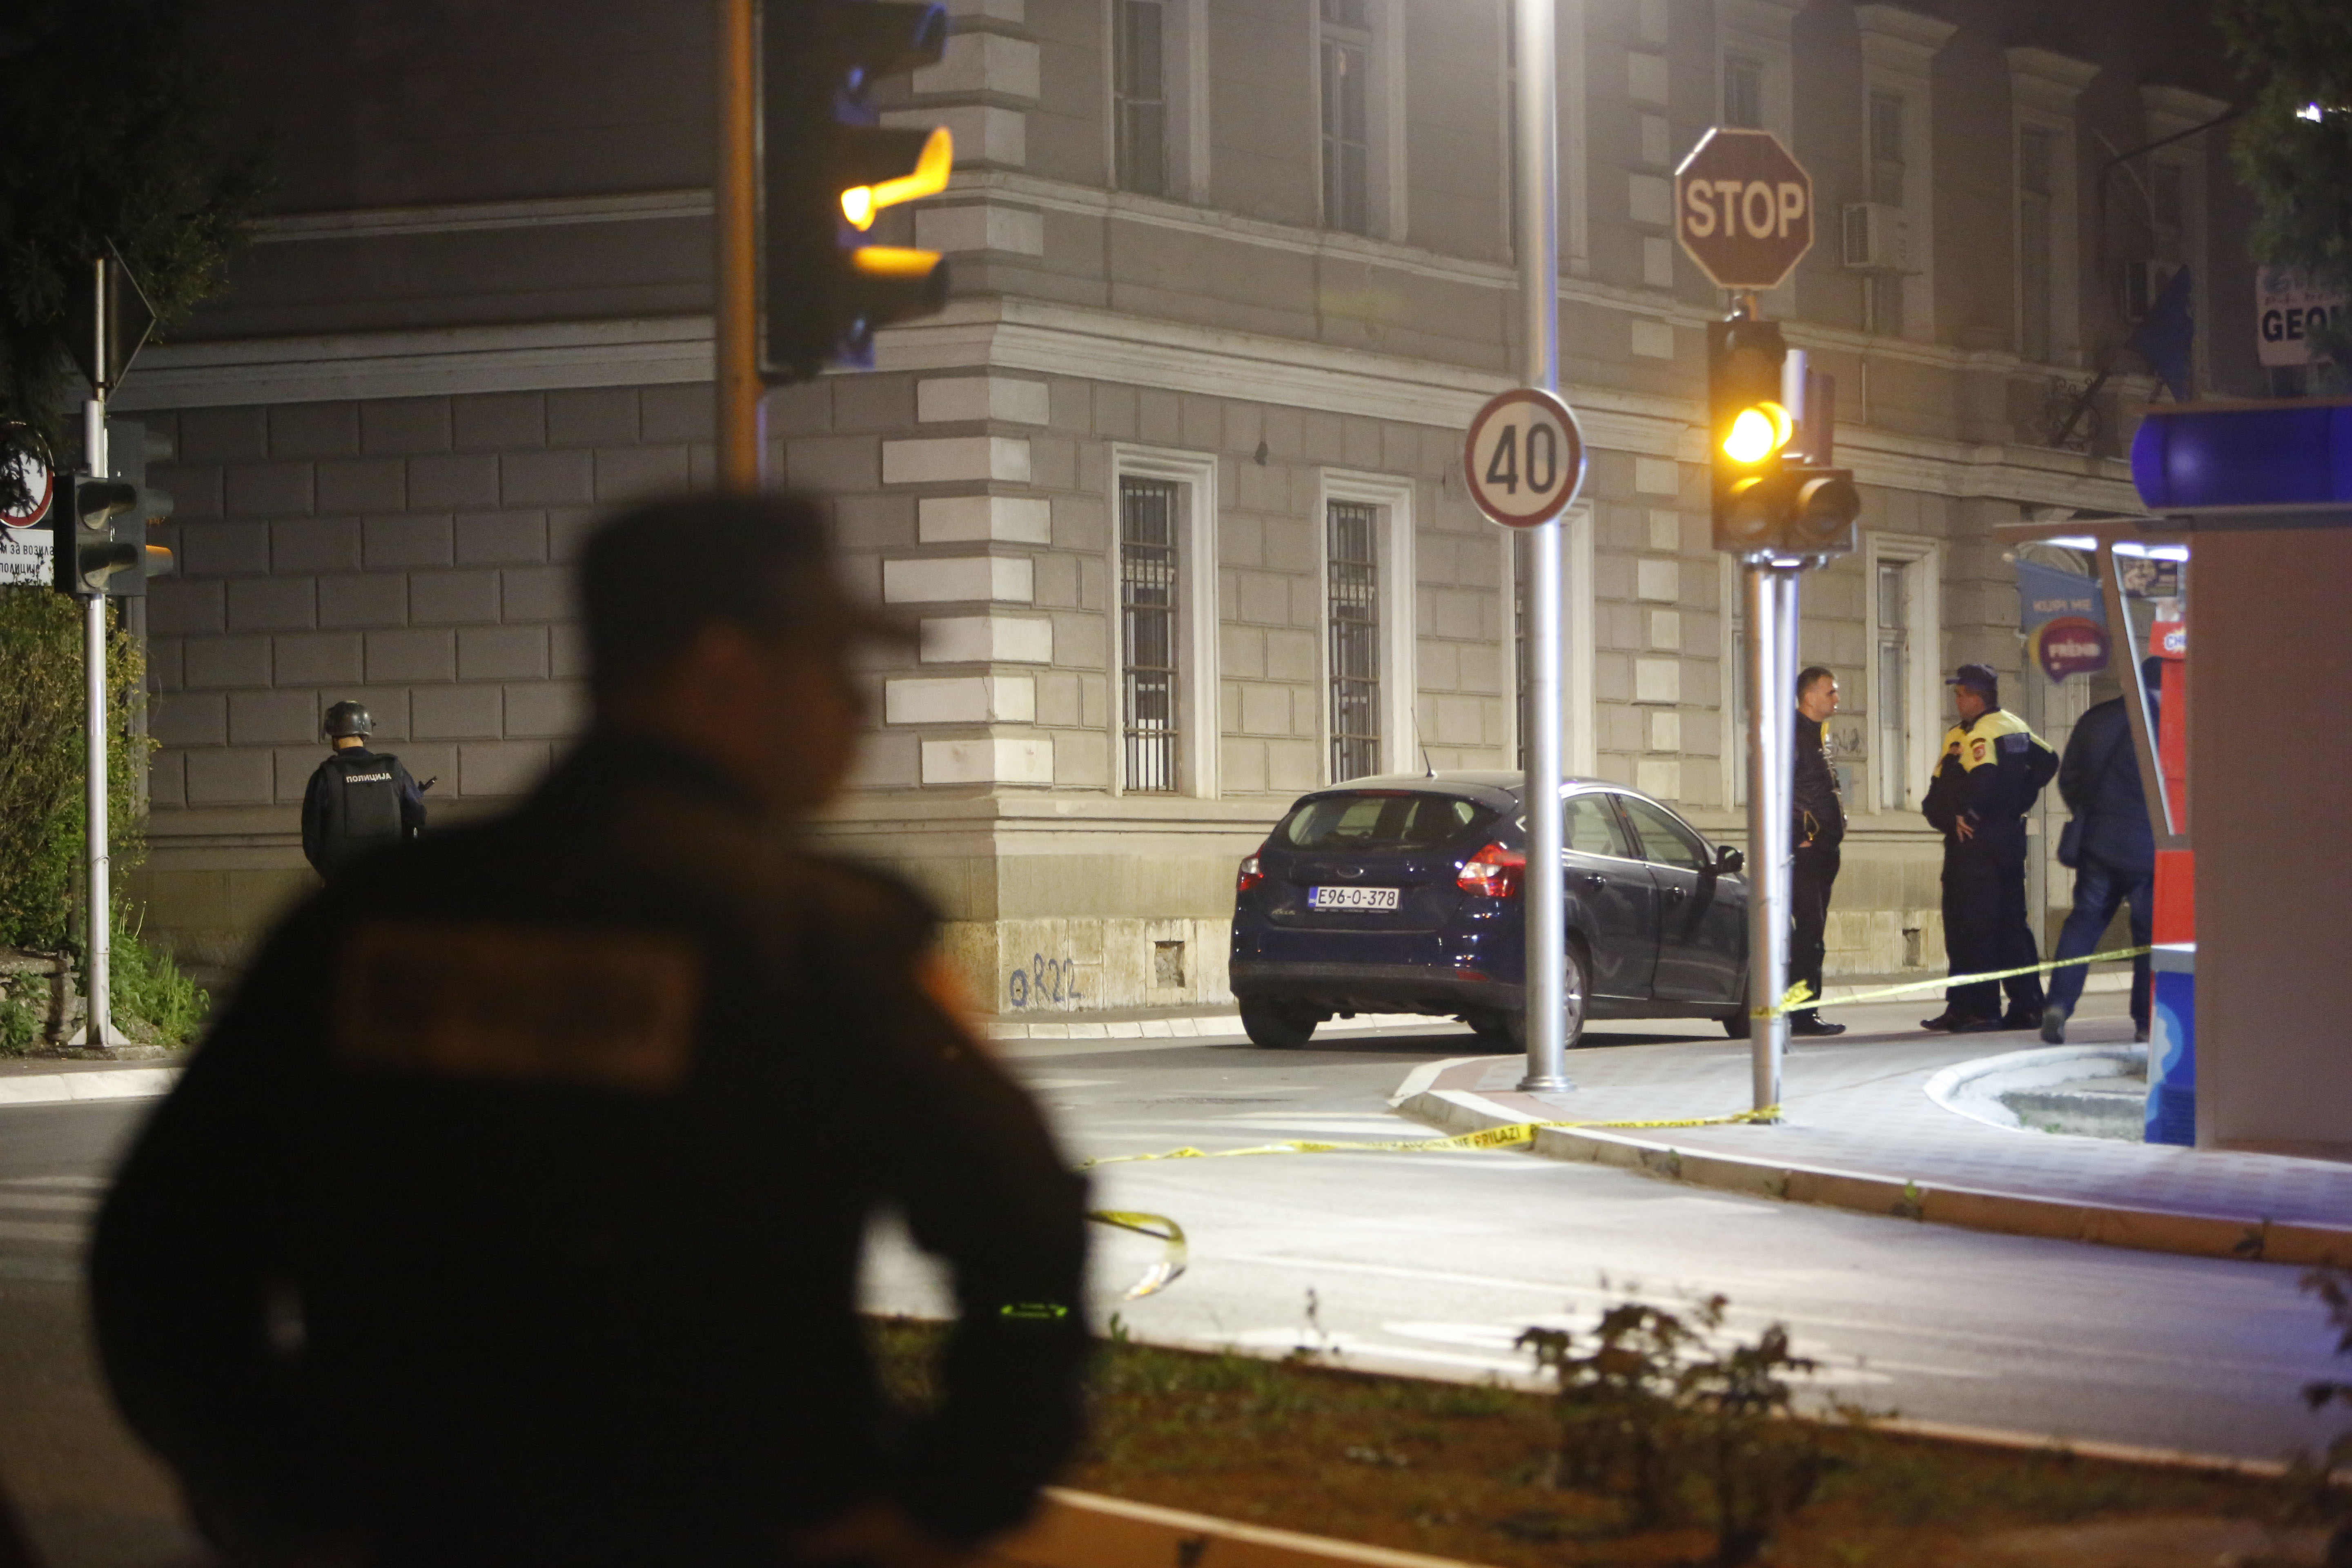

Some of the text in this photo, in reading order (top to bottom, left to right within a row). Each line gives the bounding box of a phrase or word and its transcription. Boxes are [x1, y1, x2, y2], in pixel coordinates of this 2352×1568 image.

[1686, 179, 1804, 239] STOP
[2262, 306, 2342, 343] GEO
[1486, 423, 1556, 494] 40
[346, 773, 392, 782] ПОЛИЦИЈА
[1474, 1126, 1521, 1147] PRILAZI
